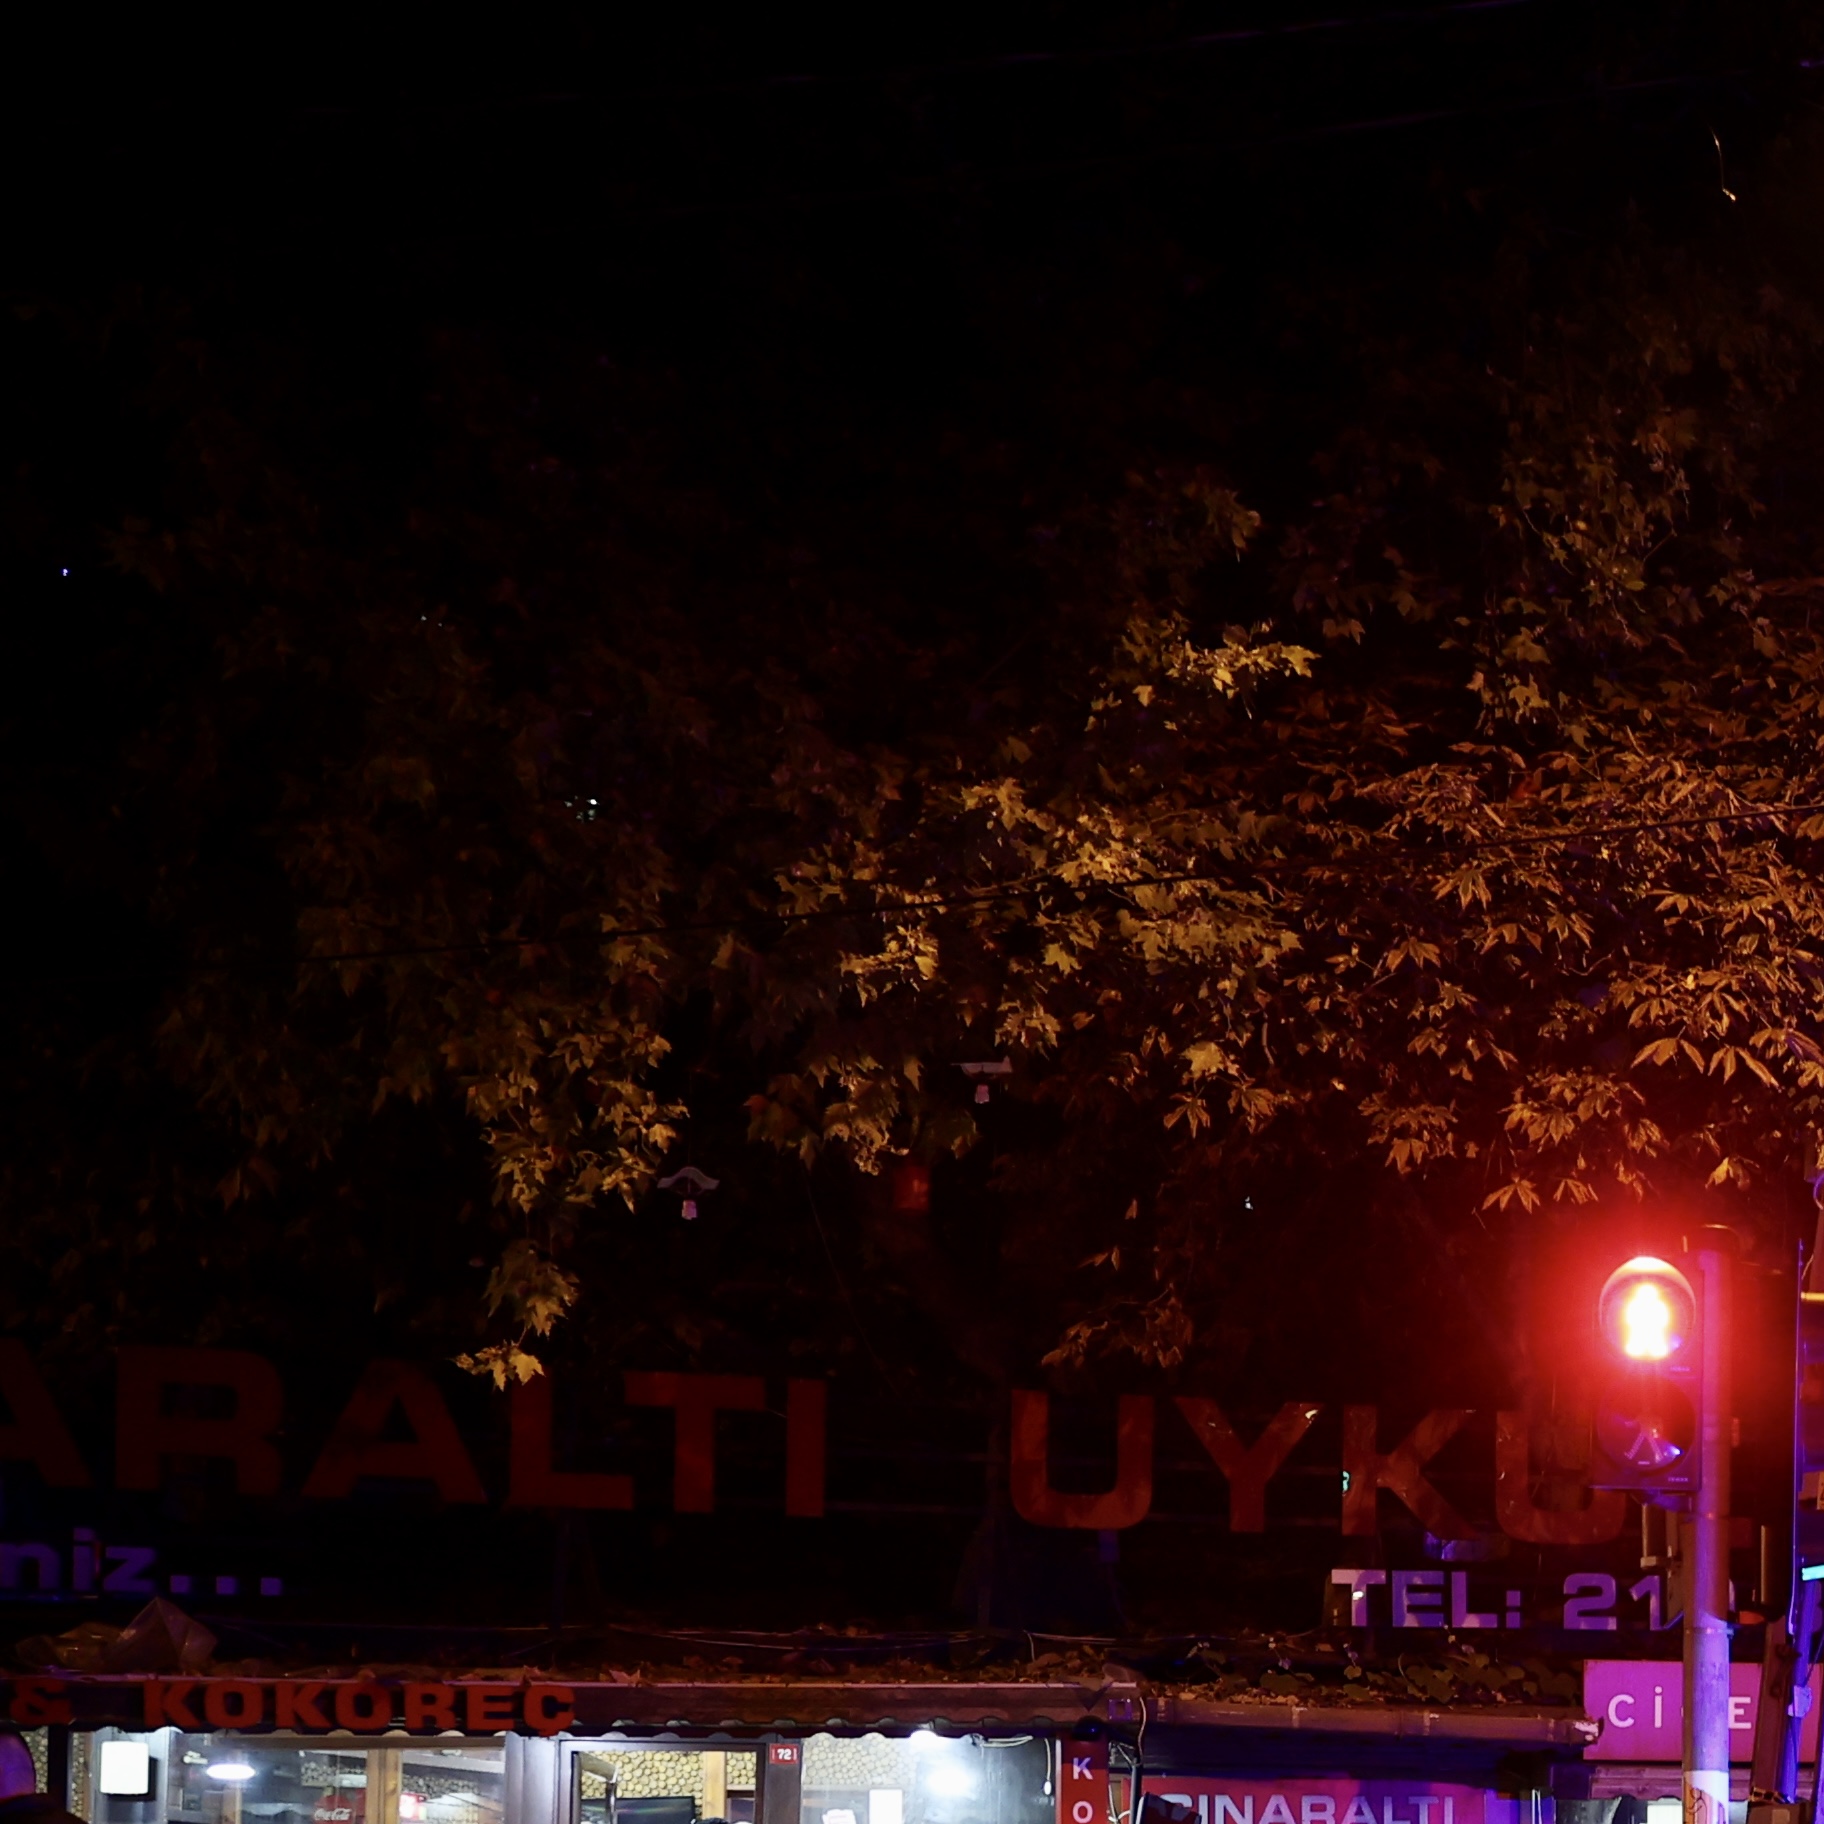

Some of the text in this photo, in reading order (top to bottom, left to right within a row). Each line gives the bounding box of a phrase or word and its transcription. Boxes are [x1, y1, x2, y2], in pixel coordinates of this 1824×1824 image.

[1331, 1570, 1523, 1629] TEL:
[143, 1680, 577, 1736] KOKOREÇ
[777, 1748, 792, 1760] 72
